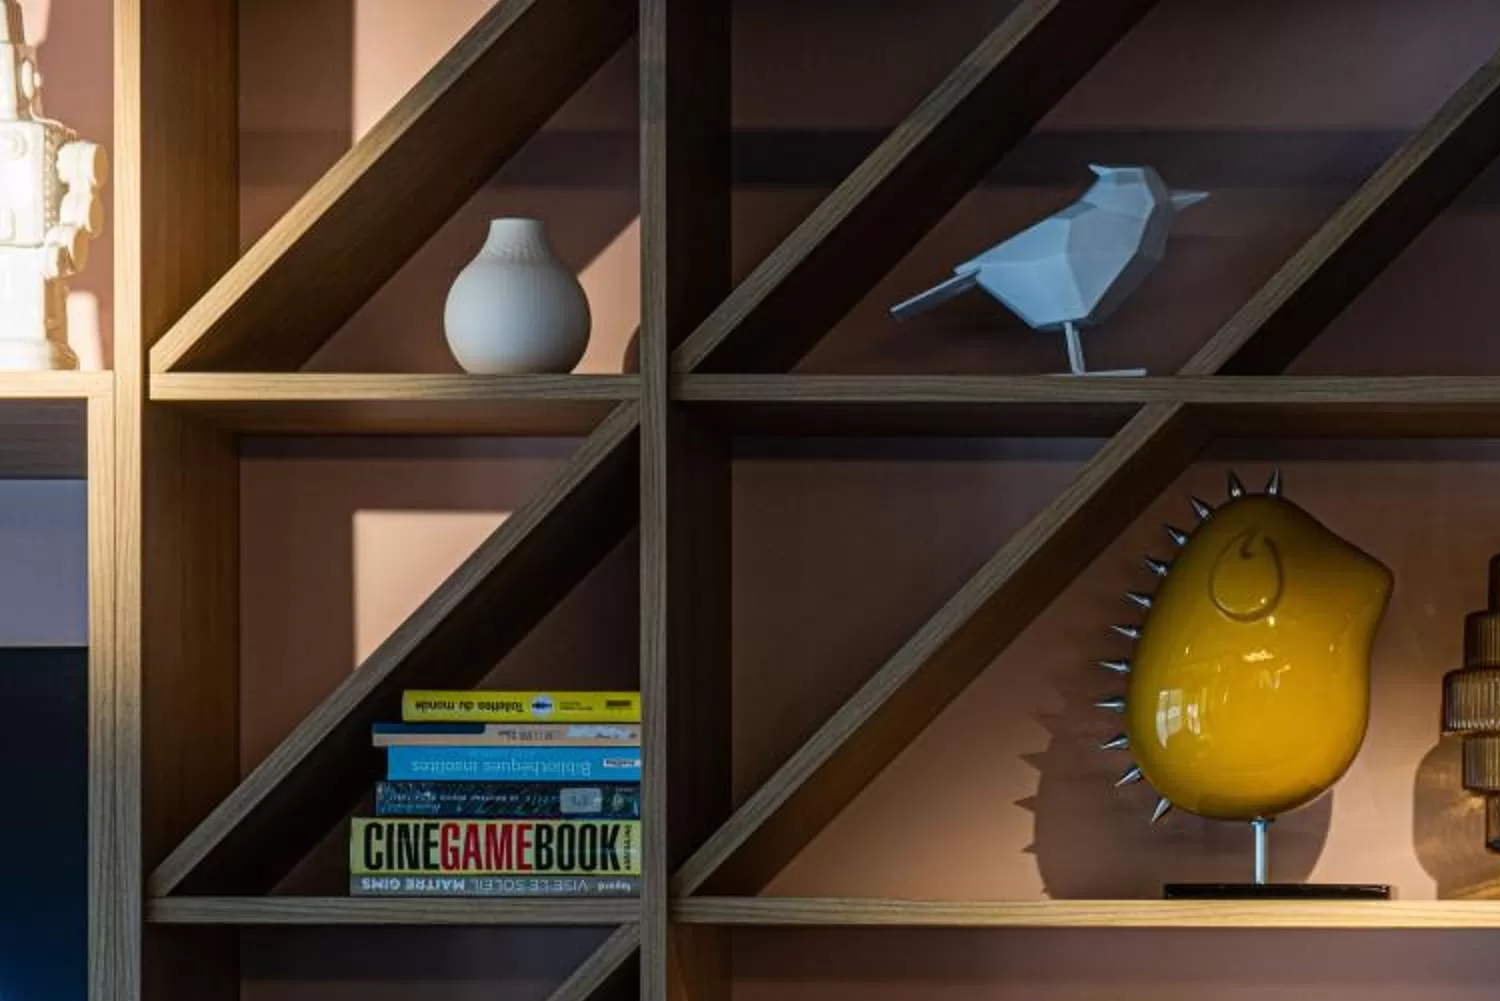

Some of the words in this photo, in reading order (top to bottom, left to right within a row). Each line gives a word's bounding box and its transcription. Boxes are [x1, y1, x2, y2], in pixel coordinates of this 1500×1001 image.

[415, 701, 456, 711] monde
[459, 701, 475, 711] du
[363, 821, 621, 871] CINEGAMEBOOK
[361, 878, 401, 890] GIMS
